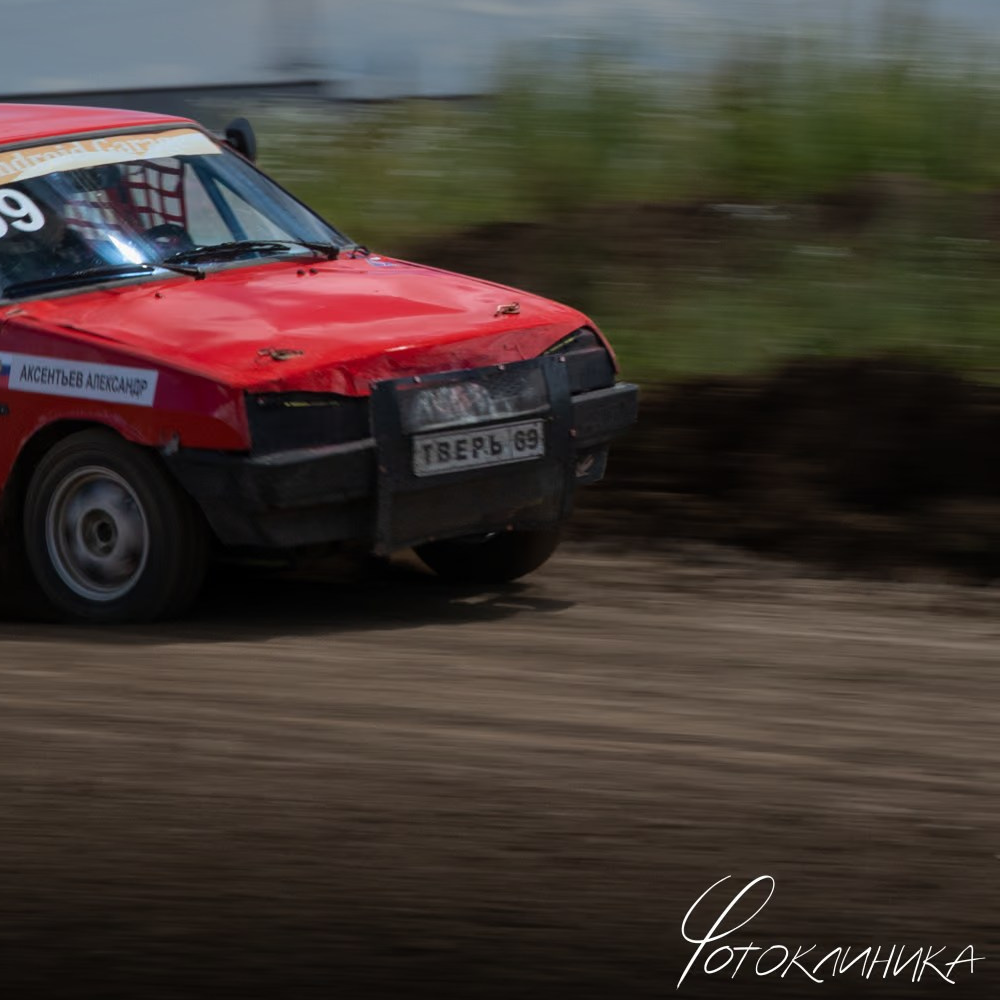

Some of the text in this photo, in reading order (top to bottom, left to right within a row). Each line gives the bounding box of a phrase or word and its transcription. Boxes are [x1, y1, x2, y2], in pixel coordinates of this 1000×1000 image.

[19, 363, 148, 399] АКСЕНТЬЕВ АЛЕКСАНДР
[421, 429, 539, 465] ТВЕРЬ 69
